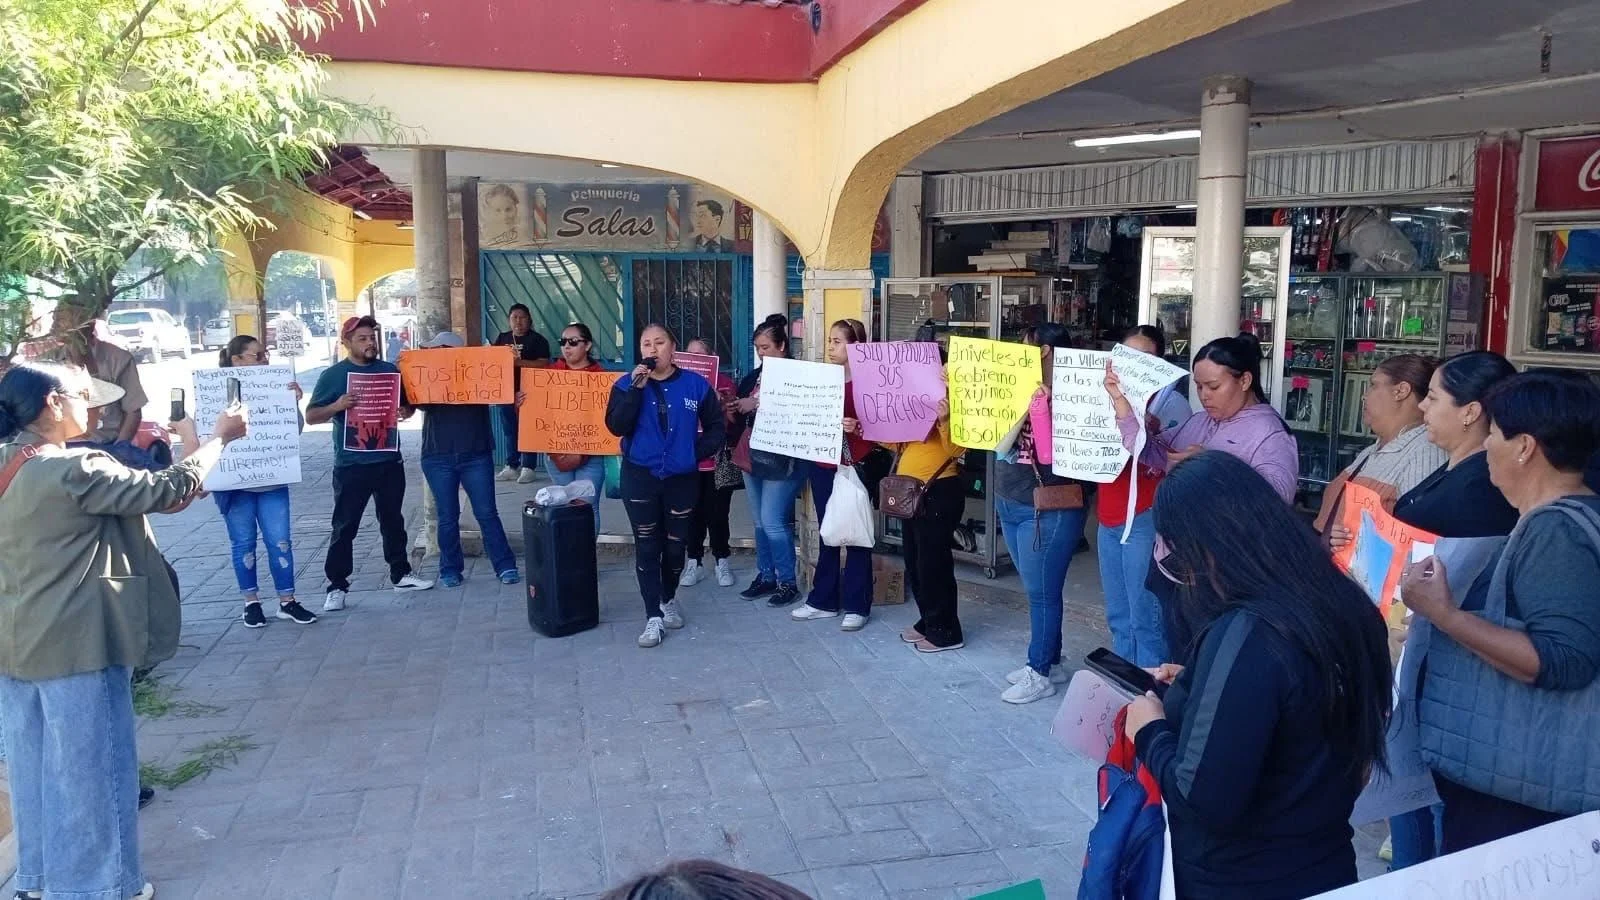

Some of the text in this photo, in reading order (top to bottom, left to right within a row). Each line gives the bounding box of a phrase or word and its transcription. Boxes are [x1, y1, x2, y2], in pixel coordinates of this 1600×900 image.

[556, 206, 656, 238] Salas
[1018, 349, 1033, 369] de
[533, 369, 617, 389] EXIGIMOS
[877, 364, 904, 389] SUS
[954, 366, 1017, 386] Gobierno
[427, 383, 502, 404] Libertad
[862, 391, 938, 424] DERCHOS
[230, 445, 273, 454] Guadalupe
[1390, 521, 1413, 545] libr
